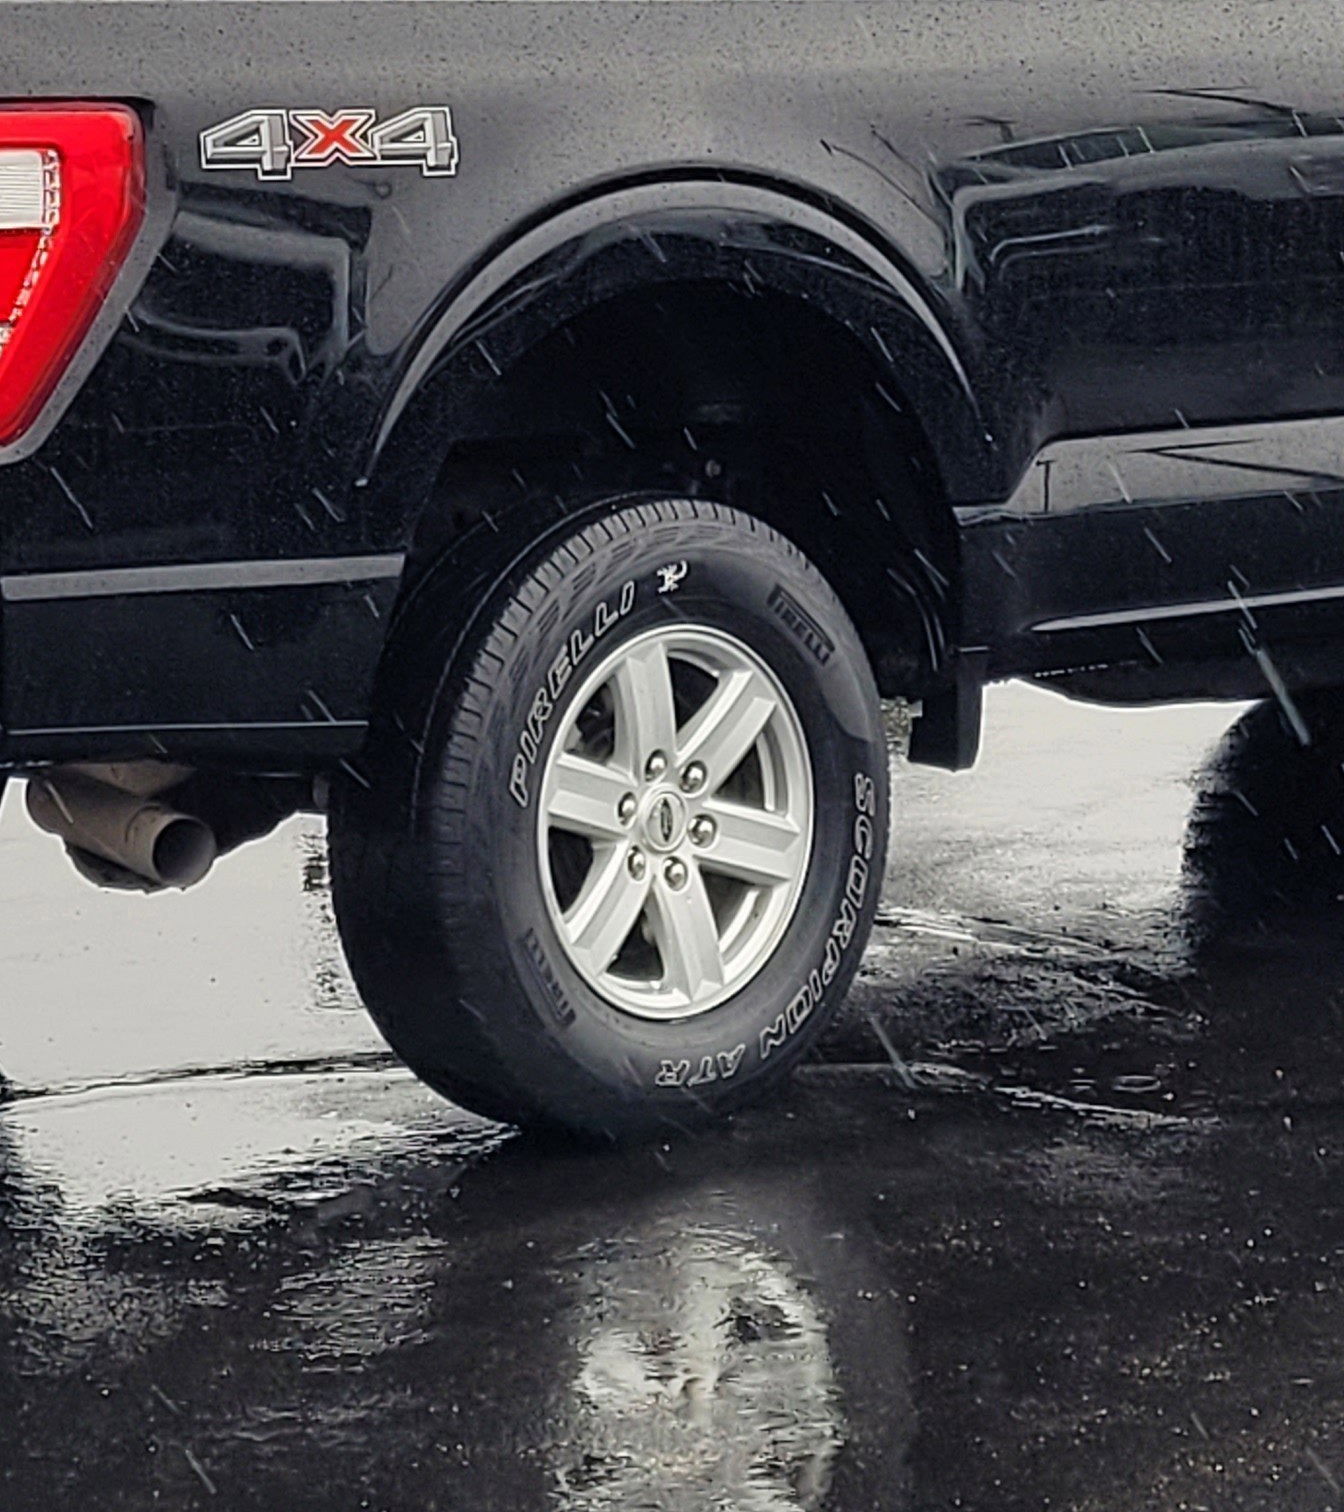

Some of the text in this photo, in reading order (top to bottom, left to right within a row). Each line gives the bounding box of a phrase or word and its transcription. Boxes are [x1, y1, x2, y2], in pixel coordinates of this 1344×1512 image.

[510, 580, 635, 808] PIRELLI
[655, 773, 875, 1087] SCORPION ATR
